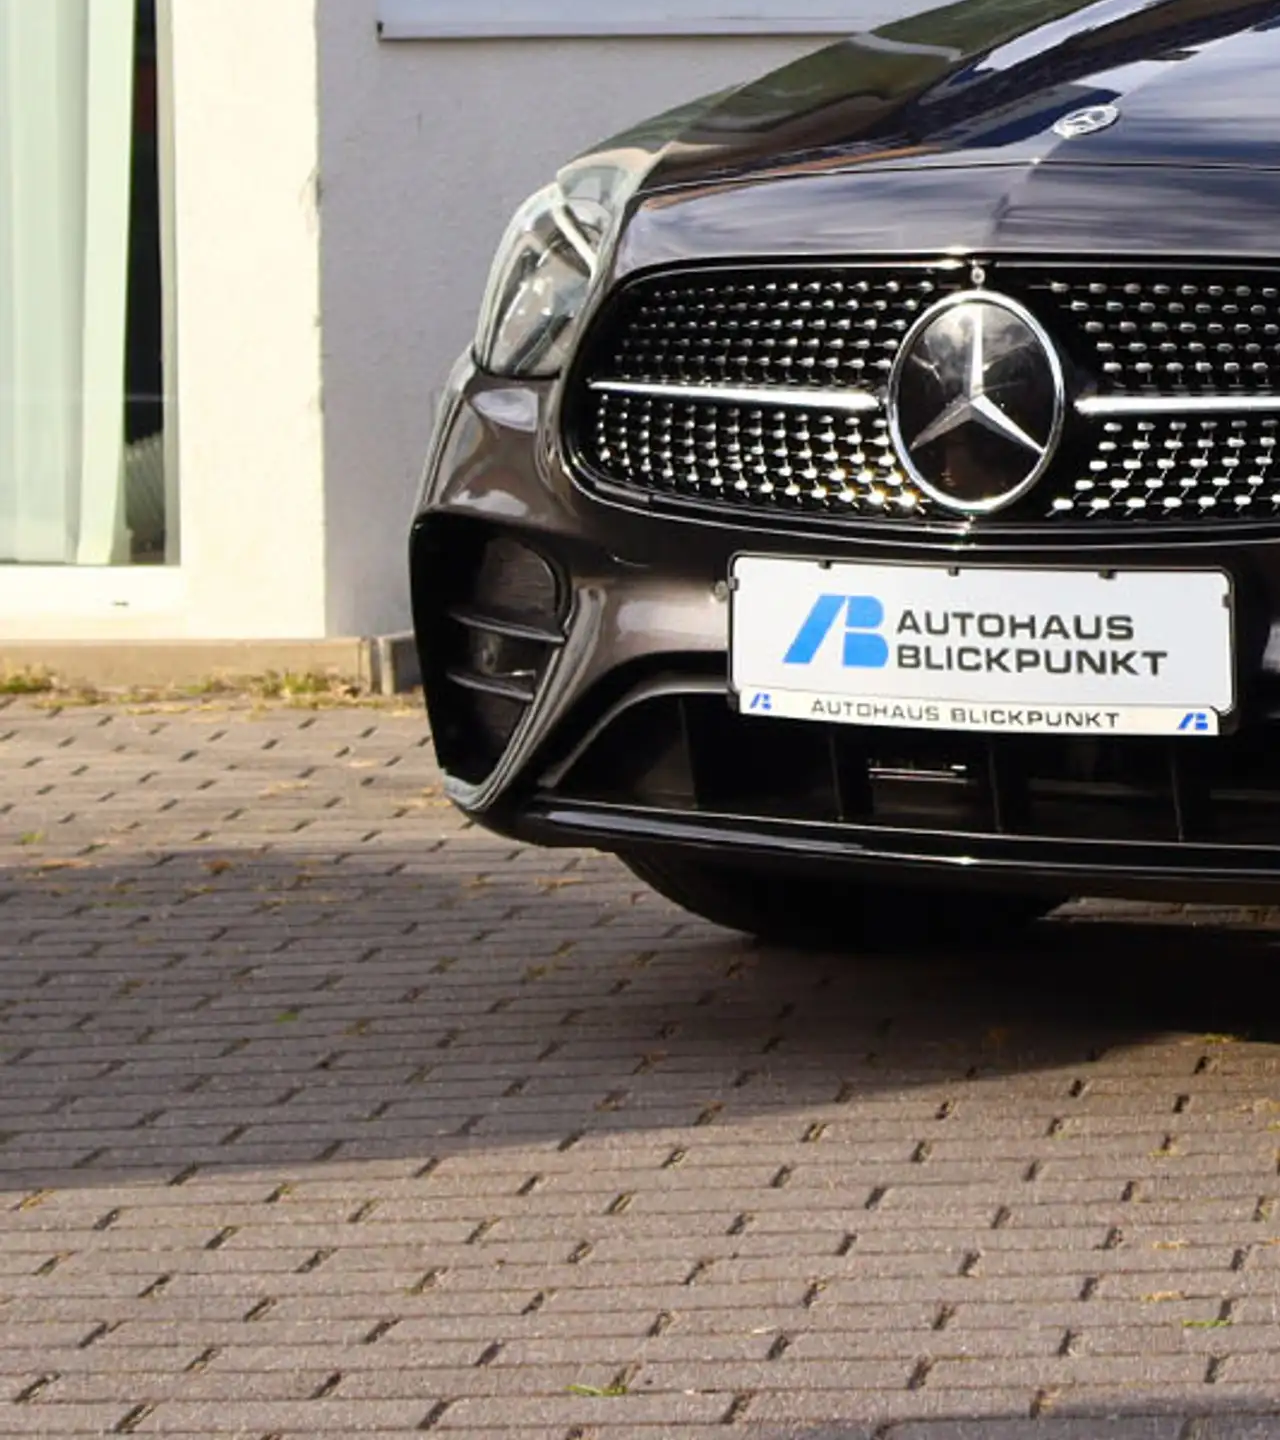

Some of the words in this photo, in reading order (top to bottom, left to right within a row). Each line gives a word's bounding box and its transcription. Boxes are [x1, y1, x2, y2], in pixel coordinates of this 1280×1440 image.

[896, 609, 1135, 641] AUTOHAUS
[897, 644, 1169, 677] BLICKPUNKT
[810, 698, 941, 722] AUTOHAUS
[950, 707, 1120, 729] BLICKPUNKT
